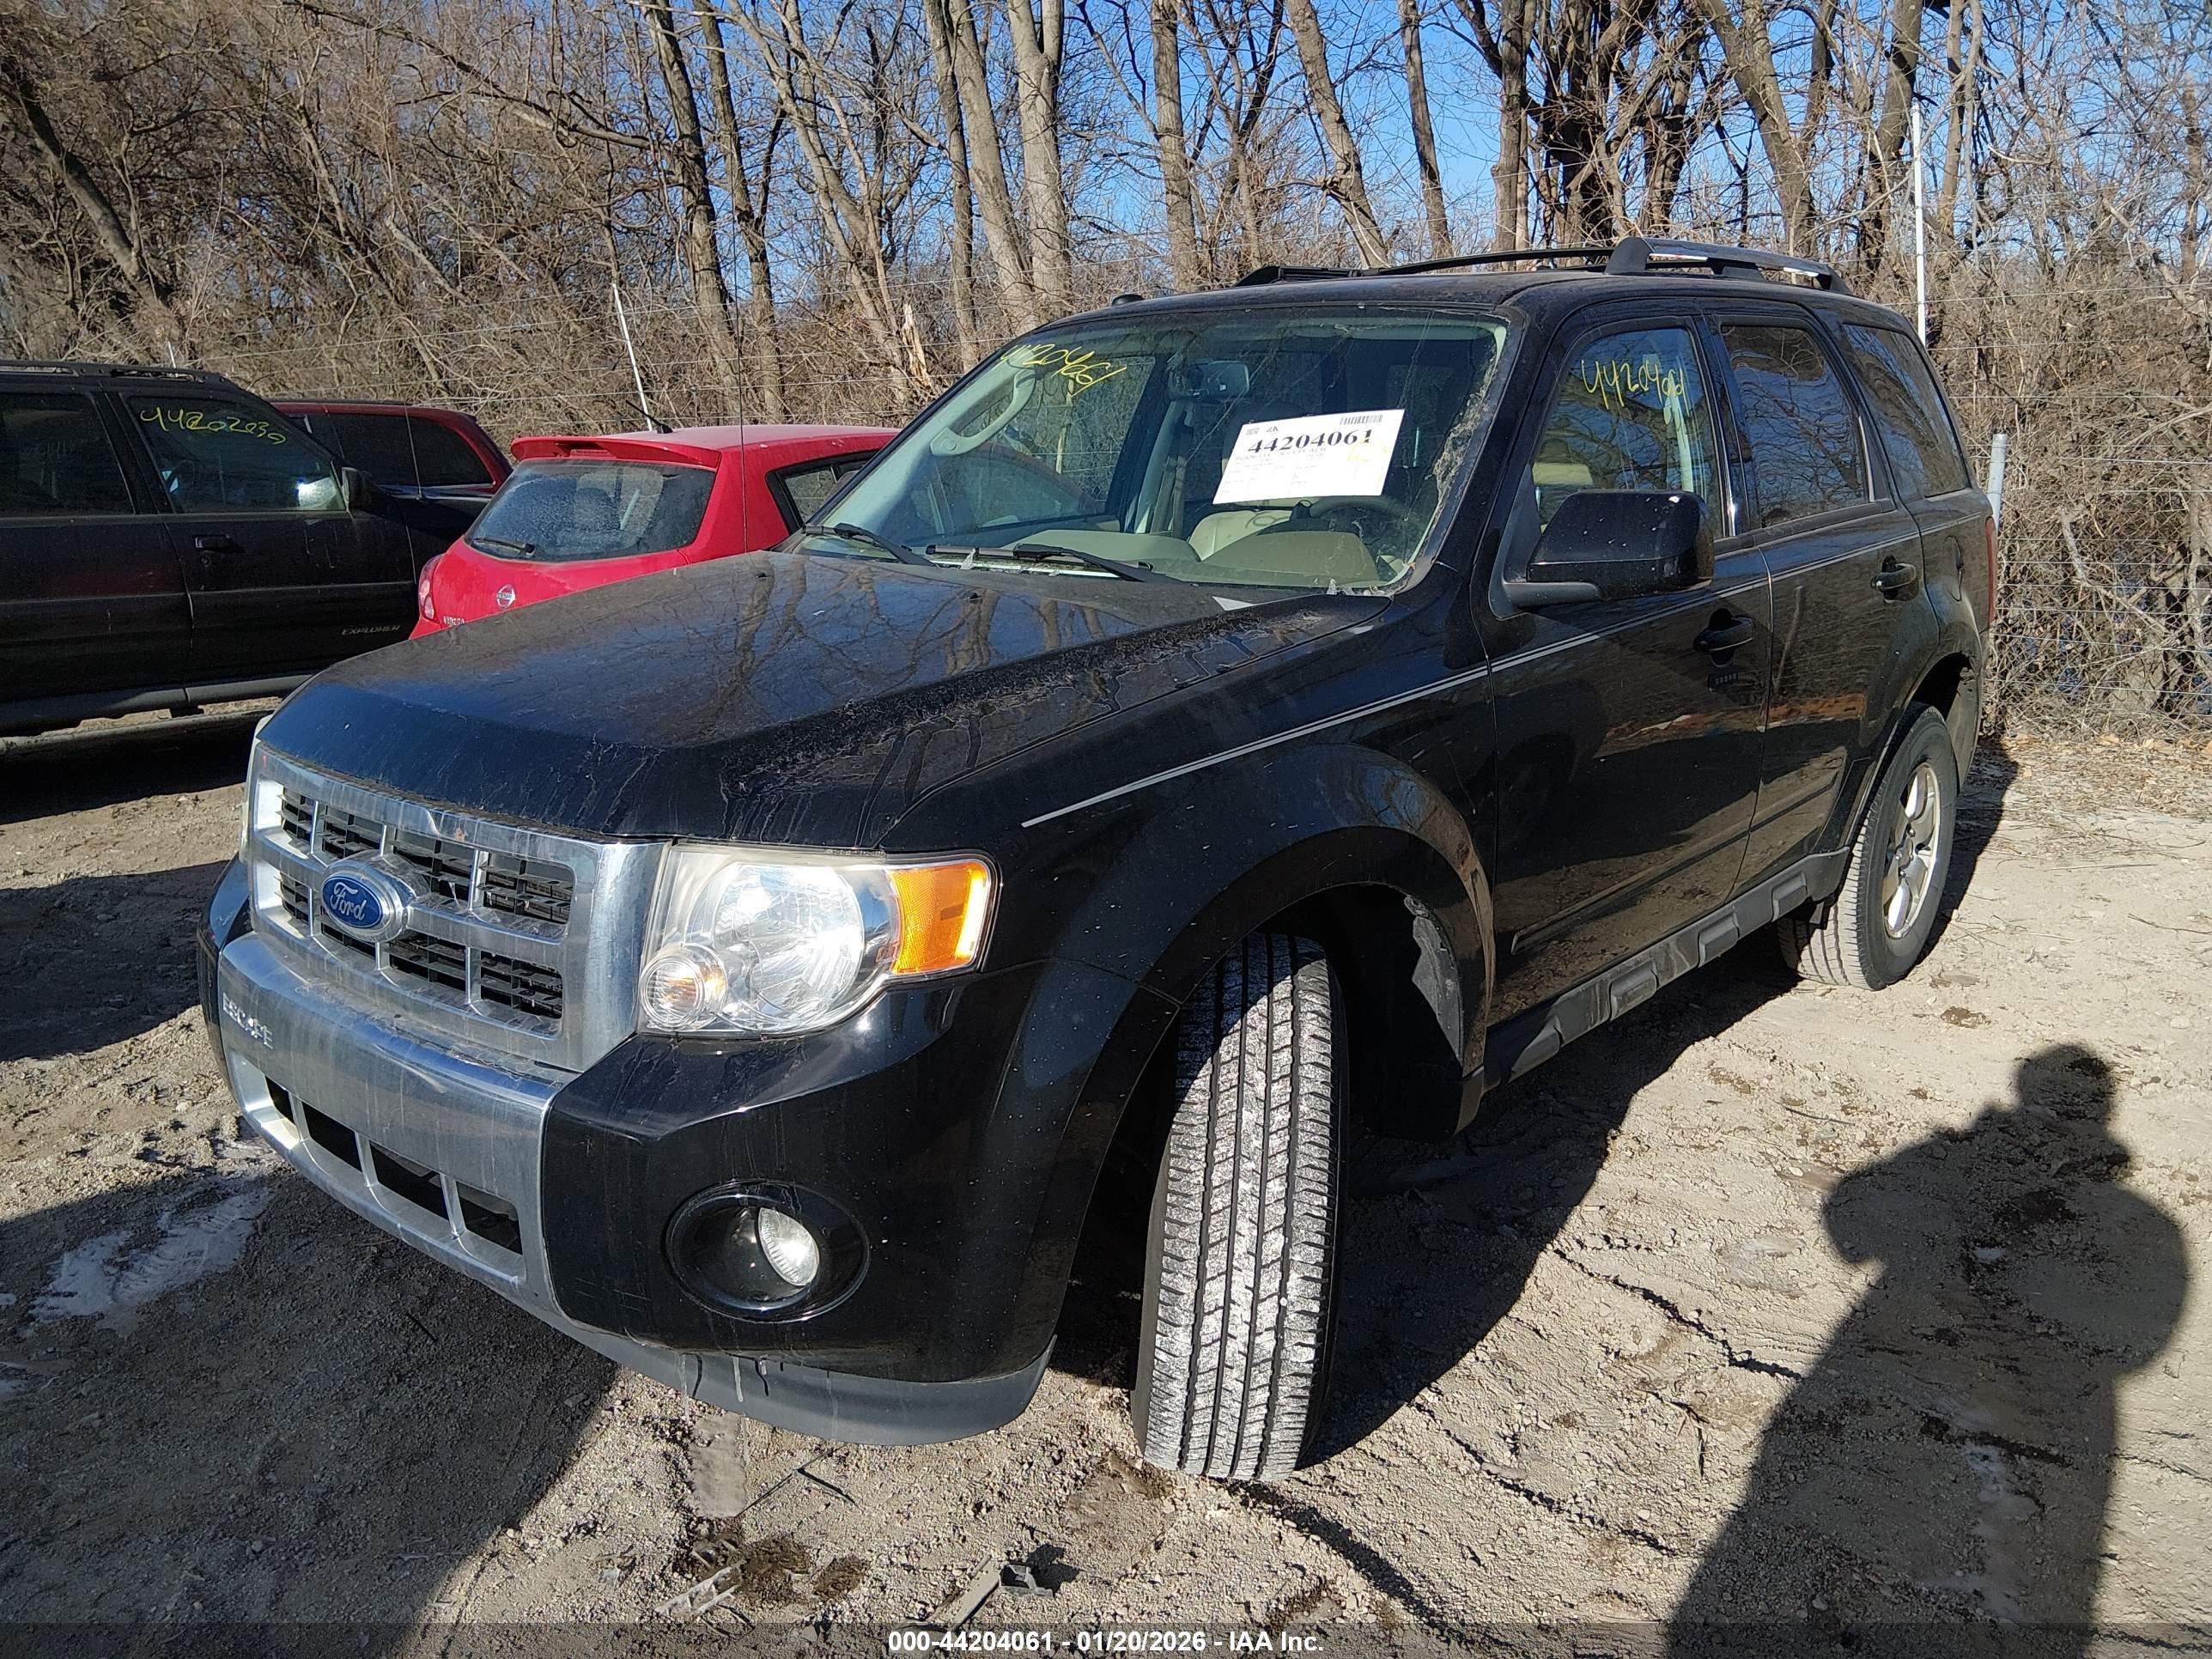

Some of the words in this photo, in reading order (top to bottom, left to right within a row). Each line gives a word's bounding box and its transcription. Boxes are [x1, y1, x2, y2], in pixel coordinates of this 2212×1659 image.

[1248, 428, 1372, 453] 44204061
[330, 882, 367, 921] Ford
[222, 992, 274, 1050] ESCAPE
